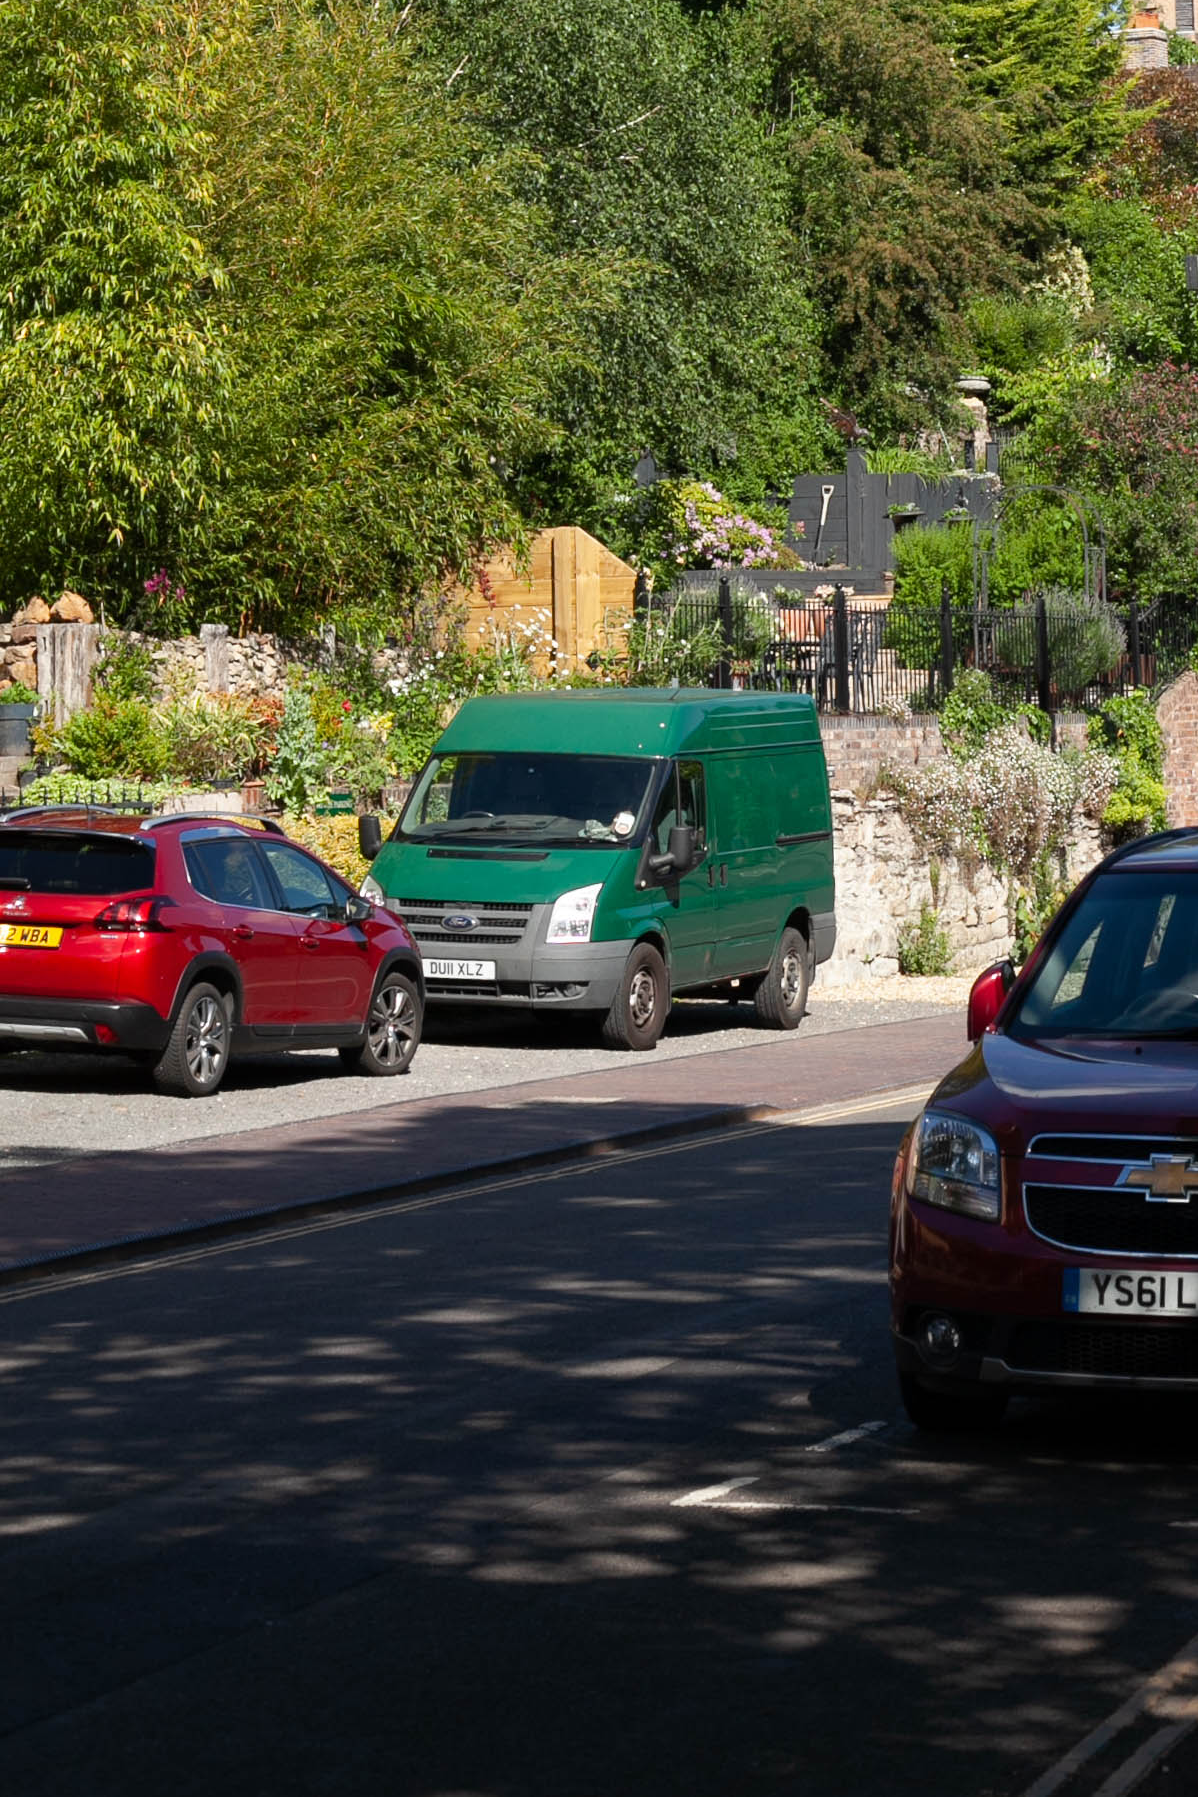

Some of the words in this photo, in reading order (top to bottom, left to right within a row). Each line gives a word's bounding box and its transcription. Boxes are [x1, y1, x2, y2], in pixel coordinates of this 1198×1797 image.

[20, 928, 49, 943] WBA
[430, 962, 453, 975] DU11
[458, 963, 484, 976] XLZ
[1092, 1274, 1166, 1308] YS61
